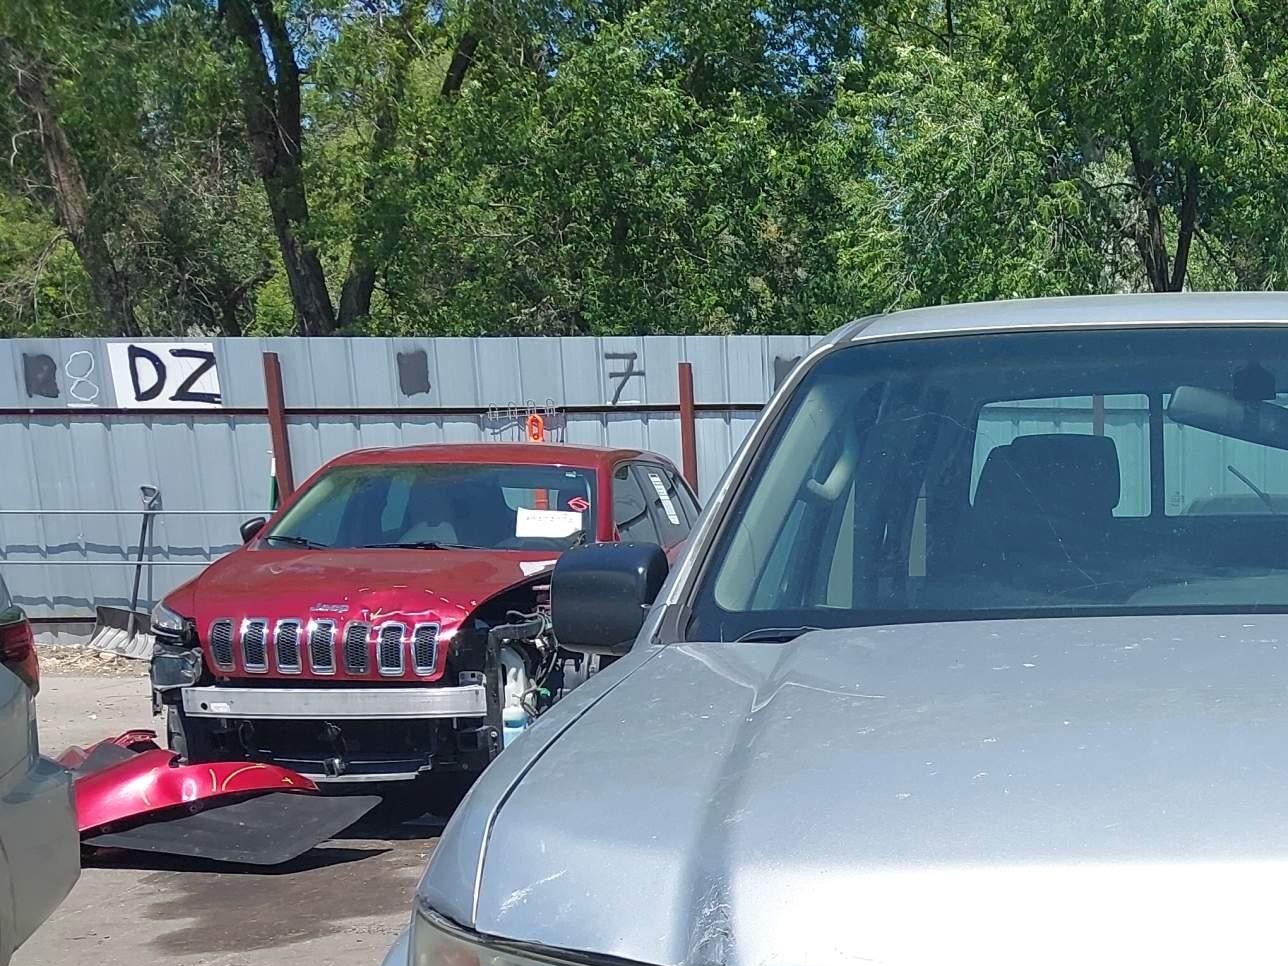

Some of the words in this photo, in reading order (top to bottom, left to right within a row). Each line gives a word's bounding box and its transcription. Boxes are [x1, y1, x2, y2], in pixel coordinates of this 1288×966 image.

[65, 350, 99, 401] 8
[127, 344, 222, 404] DZ
[604, 352, 646, 405] 7
